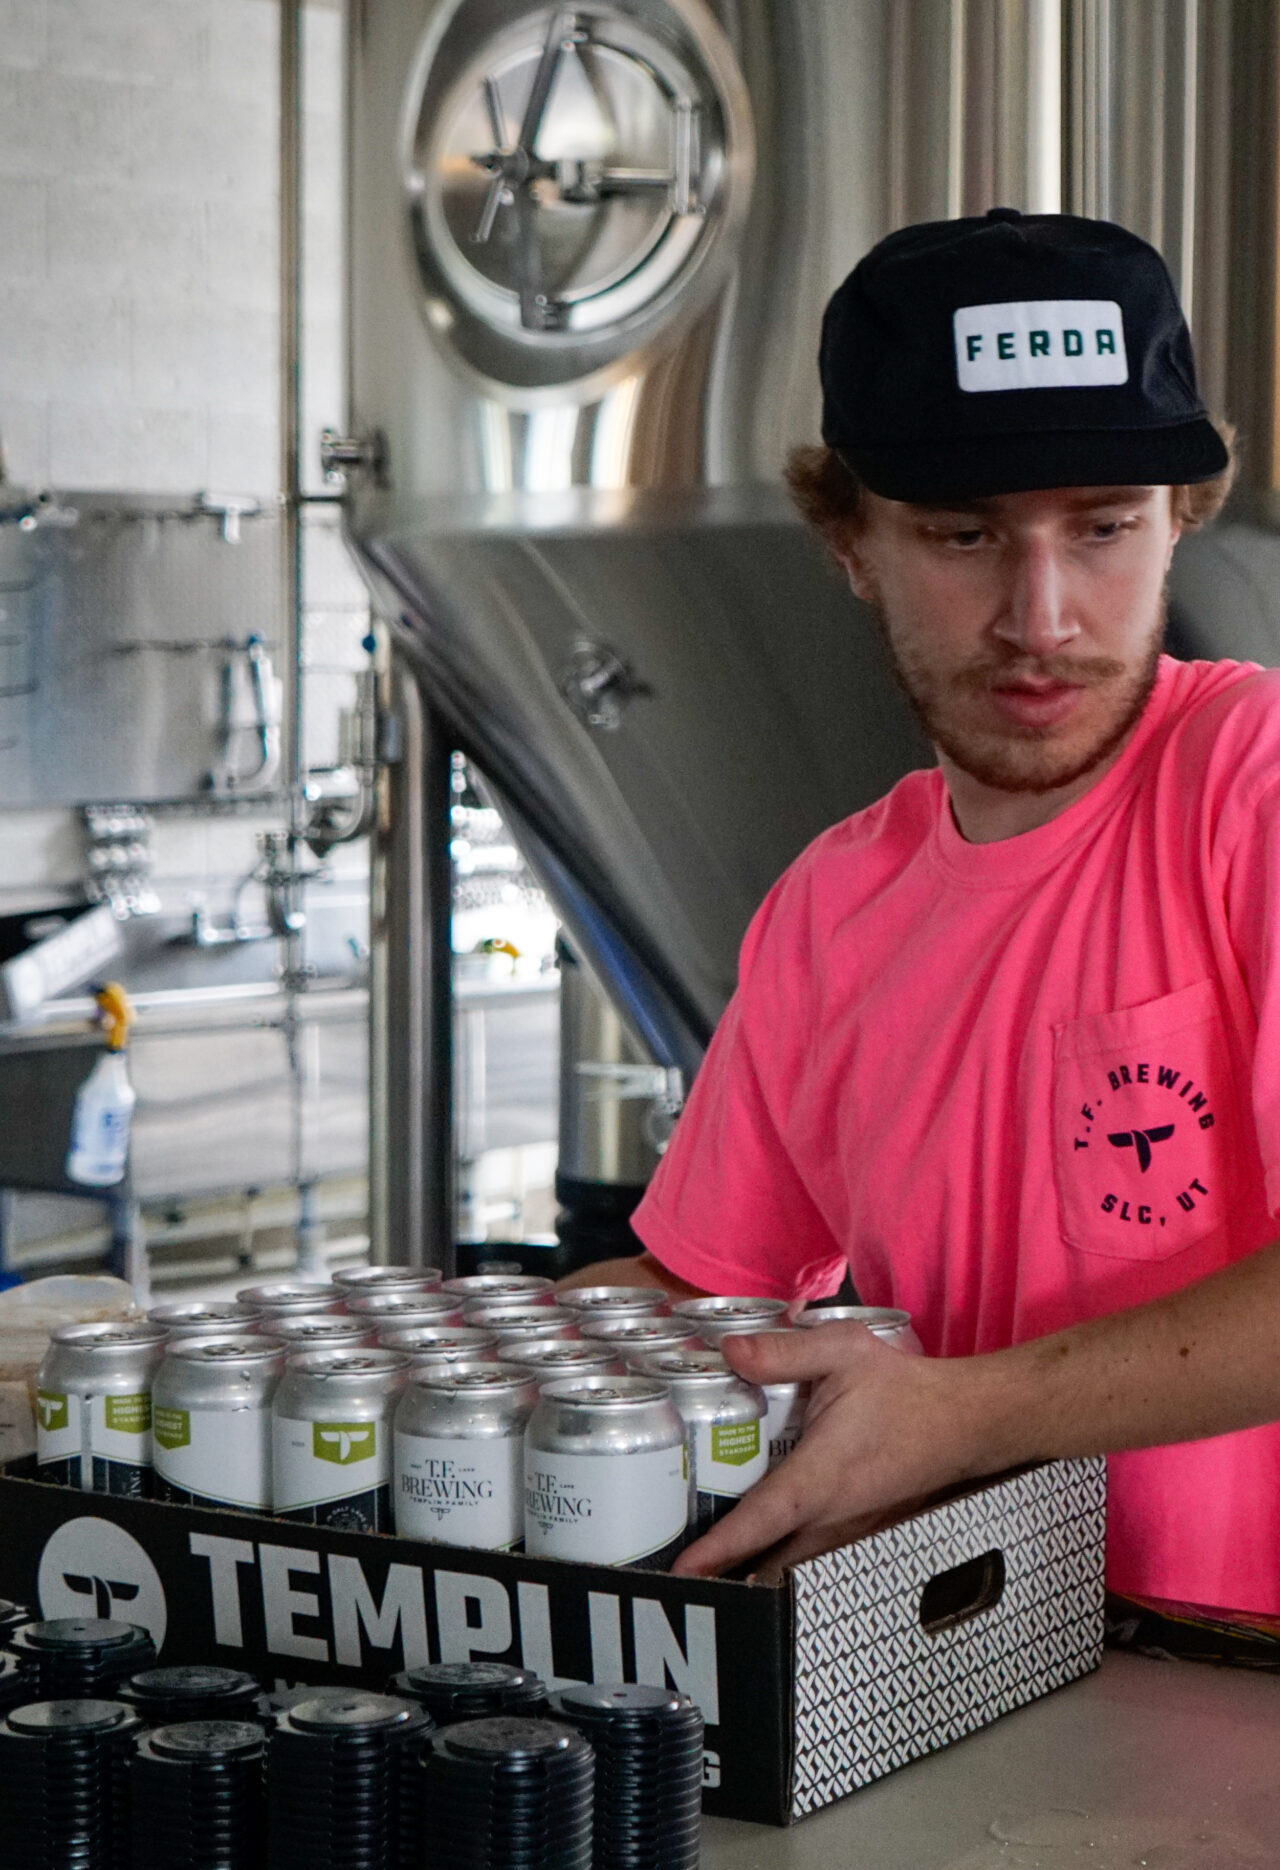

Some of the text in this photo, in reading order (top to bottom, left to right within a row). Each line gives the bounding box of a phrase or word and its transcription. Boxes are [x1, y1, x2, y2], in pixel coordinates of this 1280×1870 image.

[966, 329, 1116, 361] FERDA
[1074, 1063, 1215, 1151] T.F. BREWING
[1175, 1177, 1209, 1213] UT
[718, 1432, 756, 1447] HIGHEST
[425, 1459, 455, 1479] T.F.
[534, 1471, 558, 1494] T.F.
[402, 1473, 493, 1499] BREWING
[189, 1532, 720, 1727] TEMPLIN
